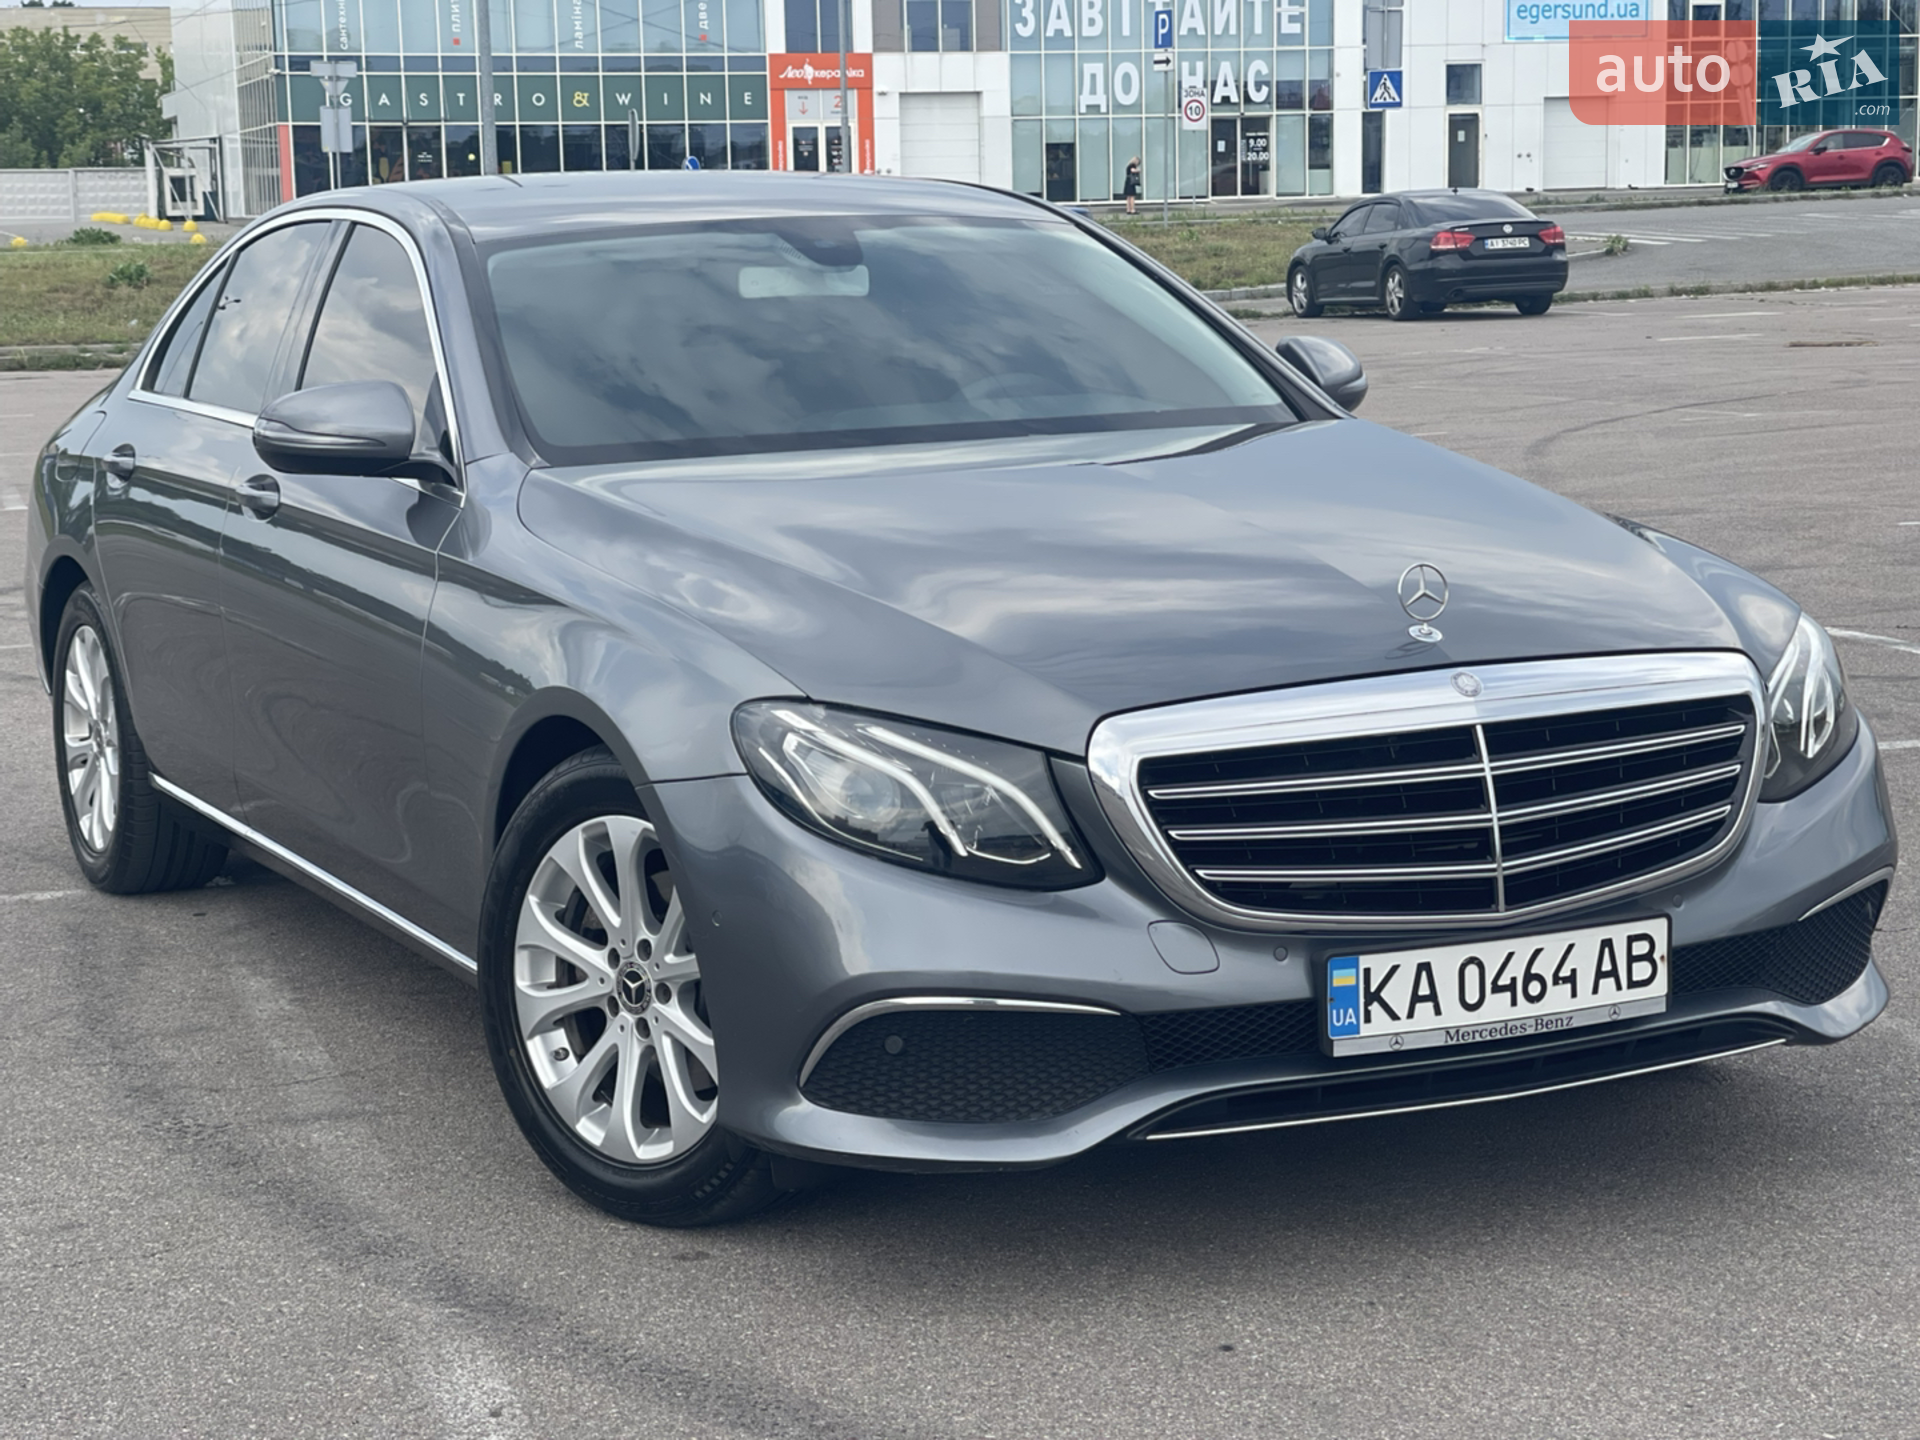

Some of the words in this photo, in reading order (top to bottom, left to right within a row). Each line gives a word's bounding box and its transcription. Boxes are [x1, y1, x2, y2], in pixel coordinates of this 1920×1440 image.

[698, 0, 709, 30] две
[1516, 0, 1640, 24] egersund.ua
[1158, 13, 1170, 45] P
[339, 92, 546, 107] GASTRO
[572, 91, 590, 108] &
[615, 92, 752, 106] WINE
[1079, 62, 1140, 113] ДО
[1181, 60, 1270, 104] НАС
[1184, 90, 1206, 98] ЗОНА
[1188, 105, 1201, 117] 10
[1363, 962, 1443, 1025] KA
[1457, 943, 1578, 1013] 0464
[1591, 932, 1659, 996] AB
[1332, 1008, 1357, 1027] UA
[1443, 1013, 1575, 1045] Mercedes-Benz
